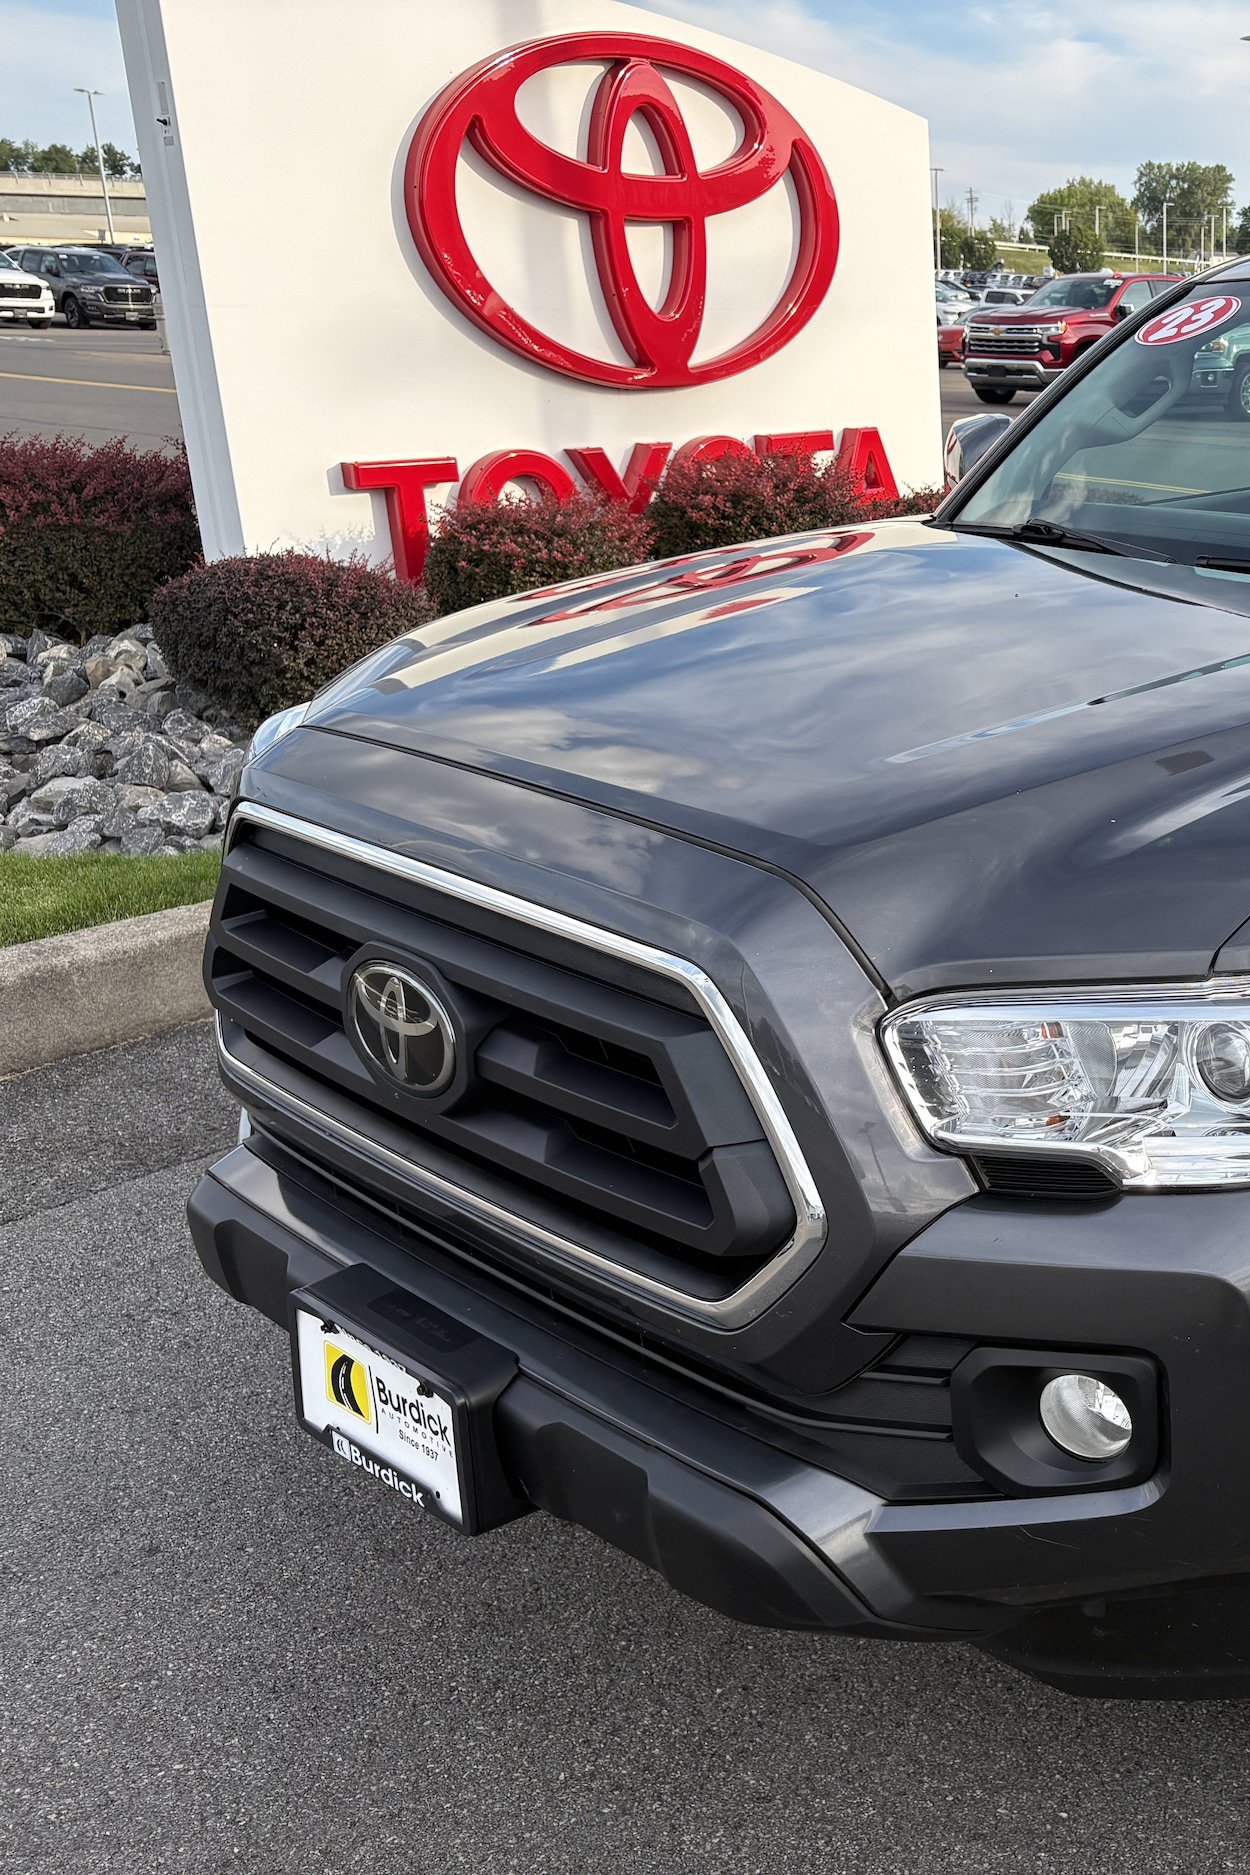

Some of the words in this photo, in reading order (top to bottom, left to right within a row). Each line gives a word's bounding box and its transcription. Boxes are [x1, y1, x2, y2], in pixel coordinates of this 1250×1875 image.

[1147, 298, 1227, 342] 23
[375, 1376, 452, 1447] Burdick
[381, 1407, 454, 1459] AUTOMOTIVE
[398, 1429, 420, 1450] Since
[421, 1444, 439, 1461] 1937
[350, 1443, 426, 1508] Burdick
